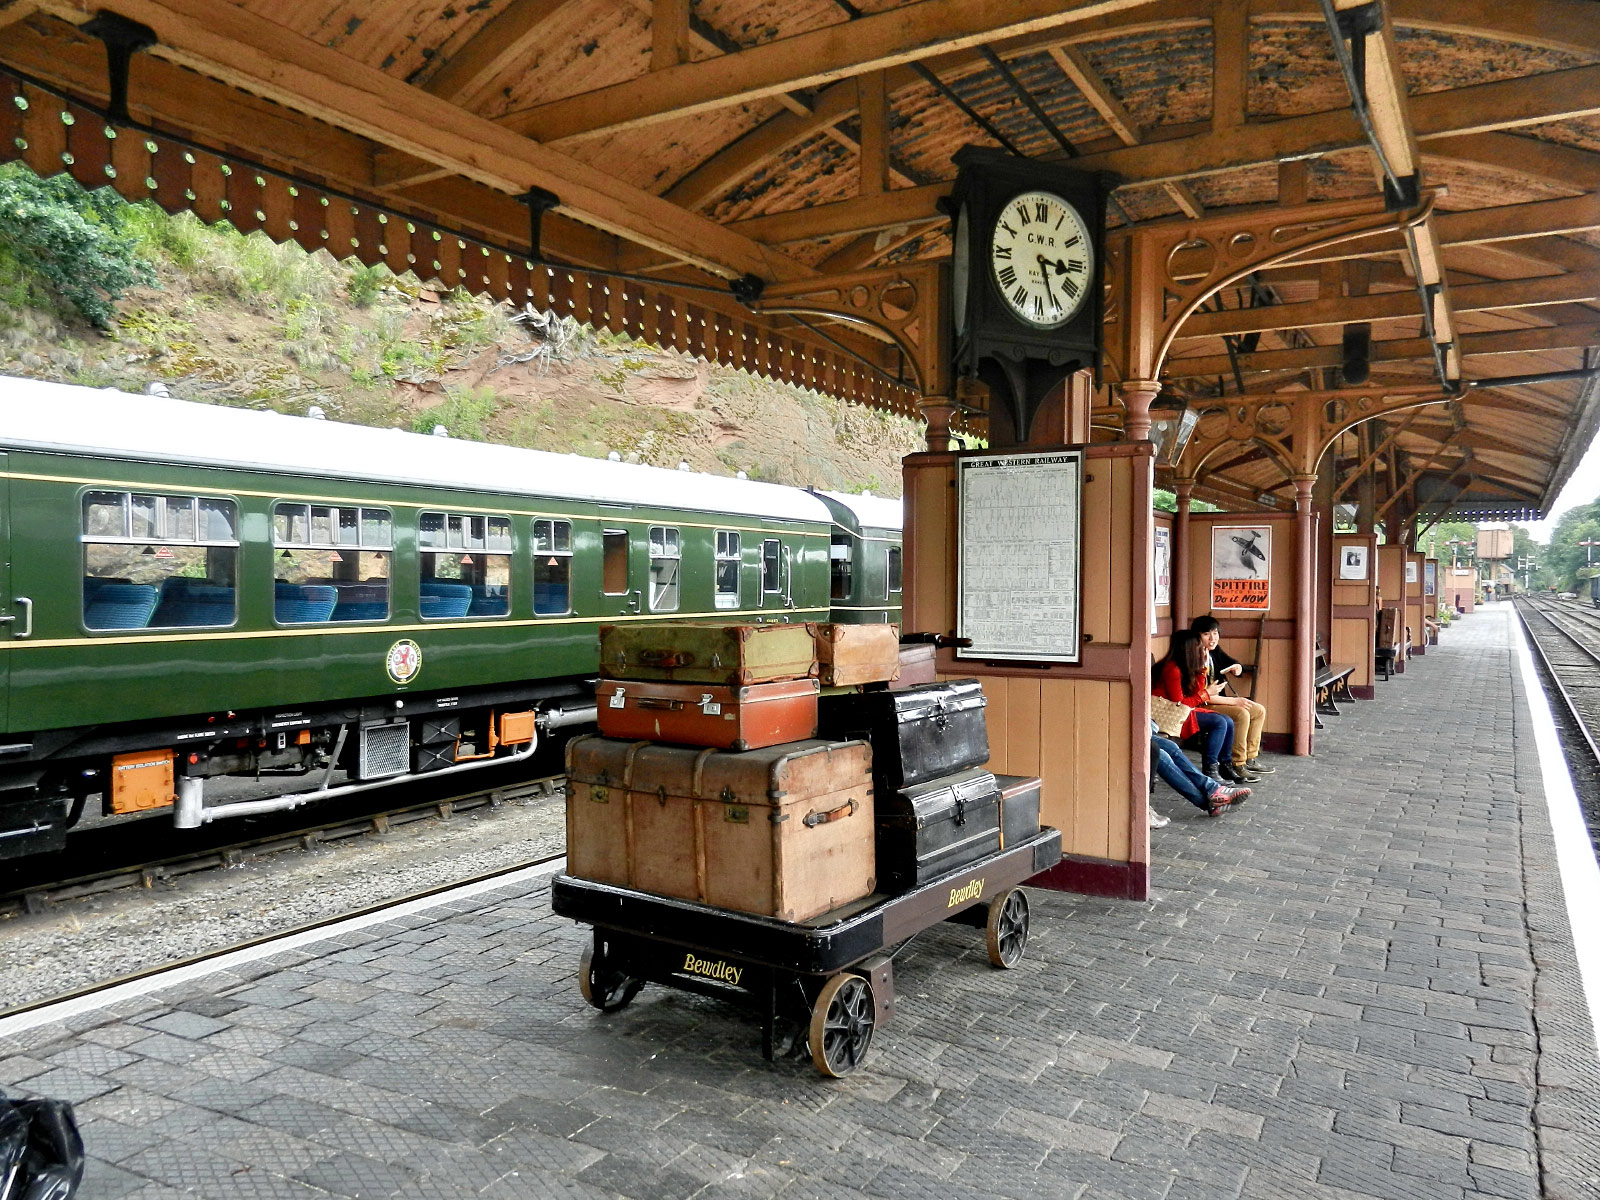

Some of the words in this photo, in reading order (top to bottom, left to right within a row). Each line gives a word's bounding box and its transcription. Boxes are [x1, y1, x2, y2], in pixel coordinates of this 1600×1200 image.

[1214, 581, 1268, 590] SPITFIRE
[1214, 595, 1227, 603] Do
[1229, 595, 1239, 603] it
[1240, 594, 1267, 603] NOW
[947, 878, 985, 908] Bewdley
[683, 953, 743, 985] Bewdley
